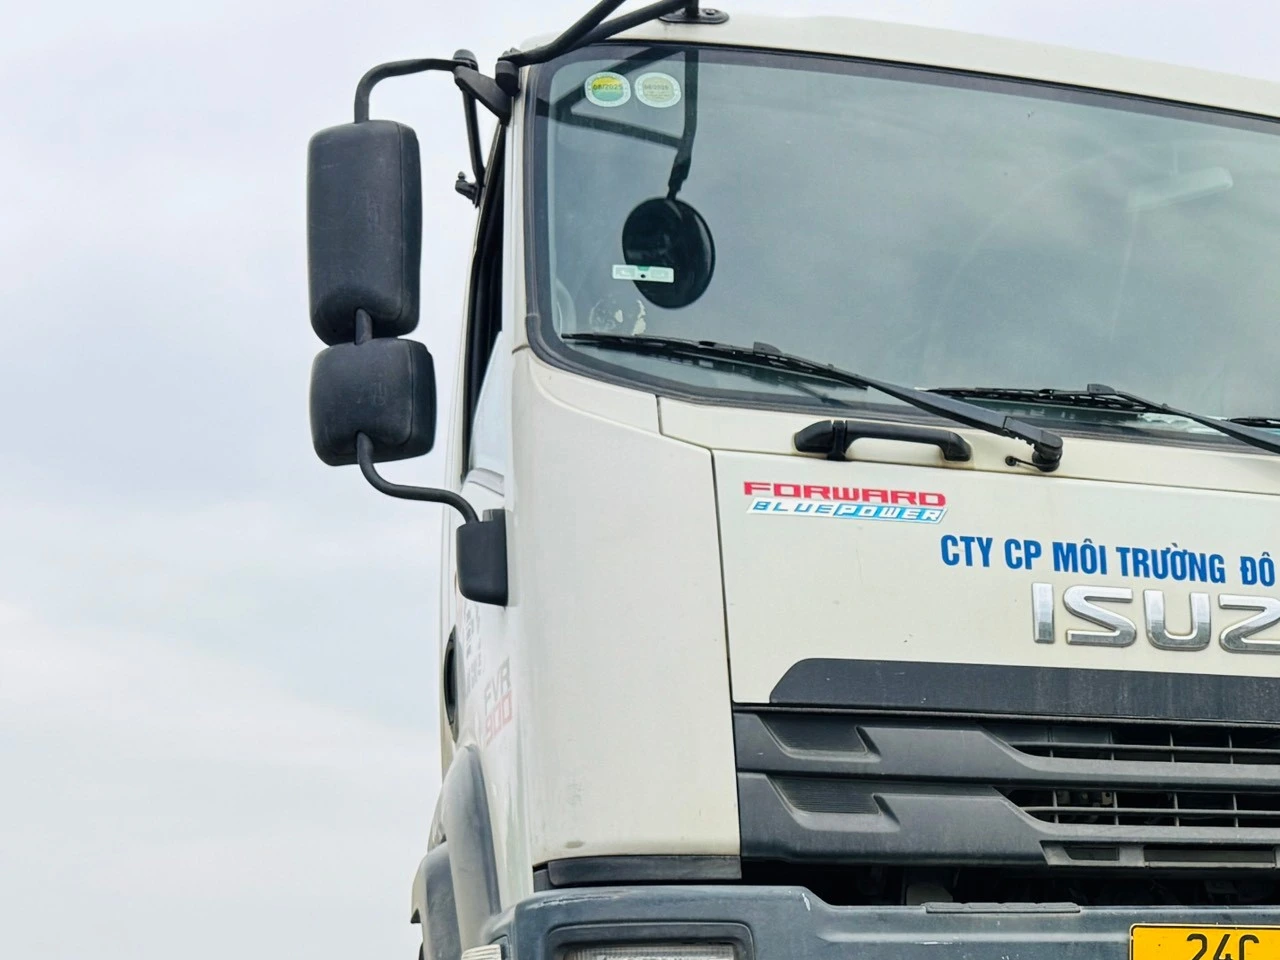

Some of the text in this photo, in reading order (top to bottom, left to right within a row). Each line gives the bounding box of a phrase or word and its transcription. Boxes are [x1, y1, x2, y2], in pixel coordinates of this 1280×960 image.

[744, 481, 946, 507] FORWARD
[940, 534, 993, 567] CTY
[1004, 539, 1042, 570] CP
[1052, 538, 1107, 575] MÔI
[1116, 542, 1226, 583] TRƯỜNG
[1240, 551, 1276, 586] ĐÔ
